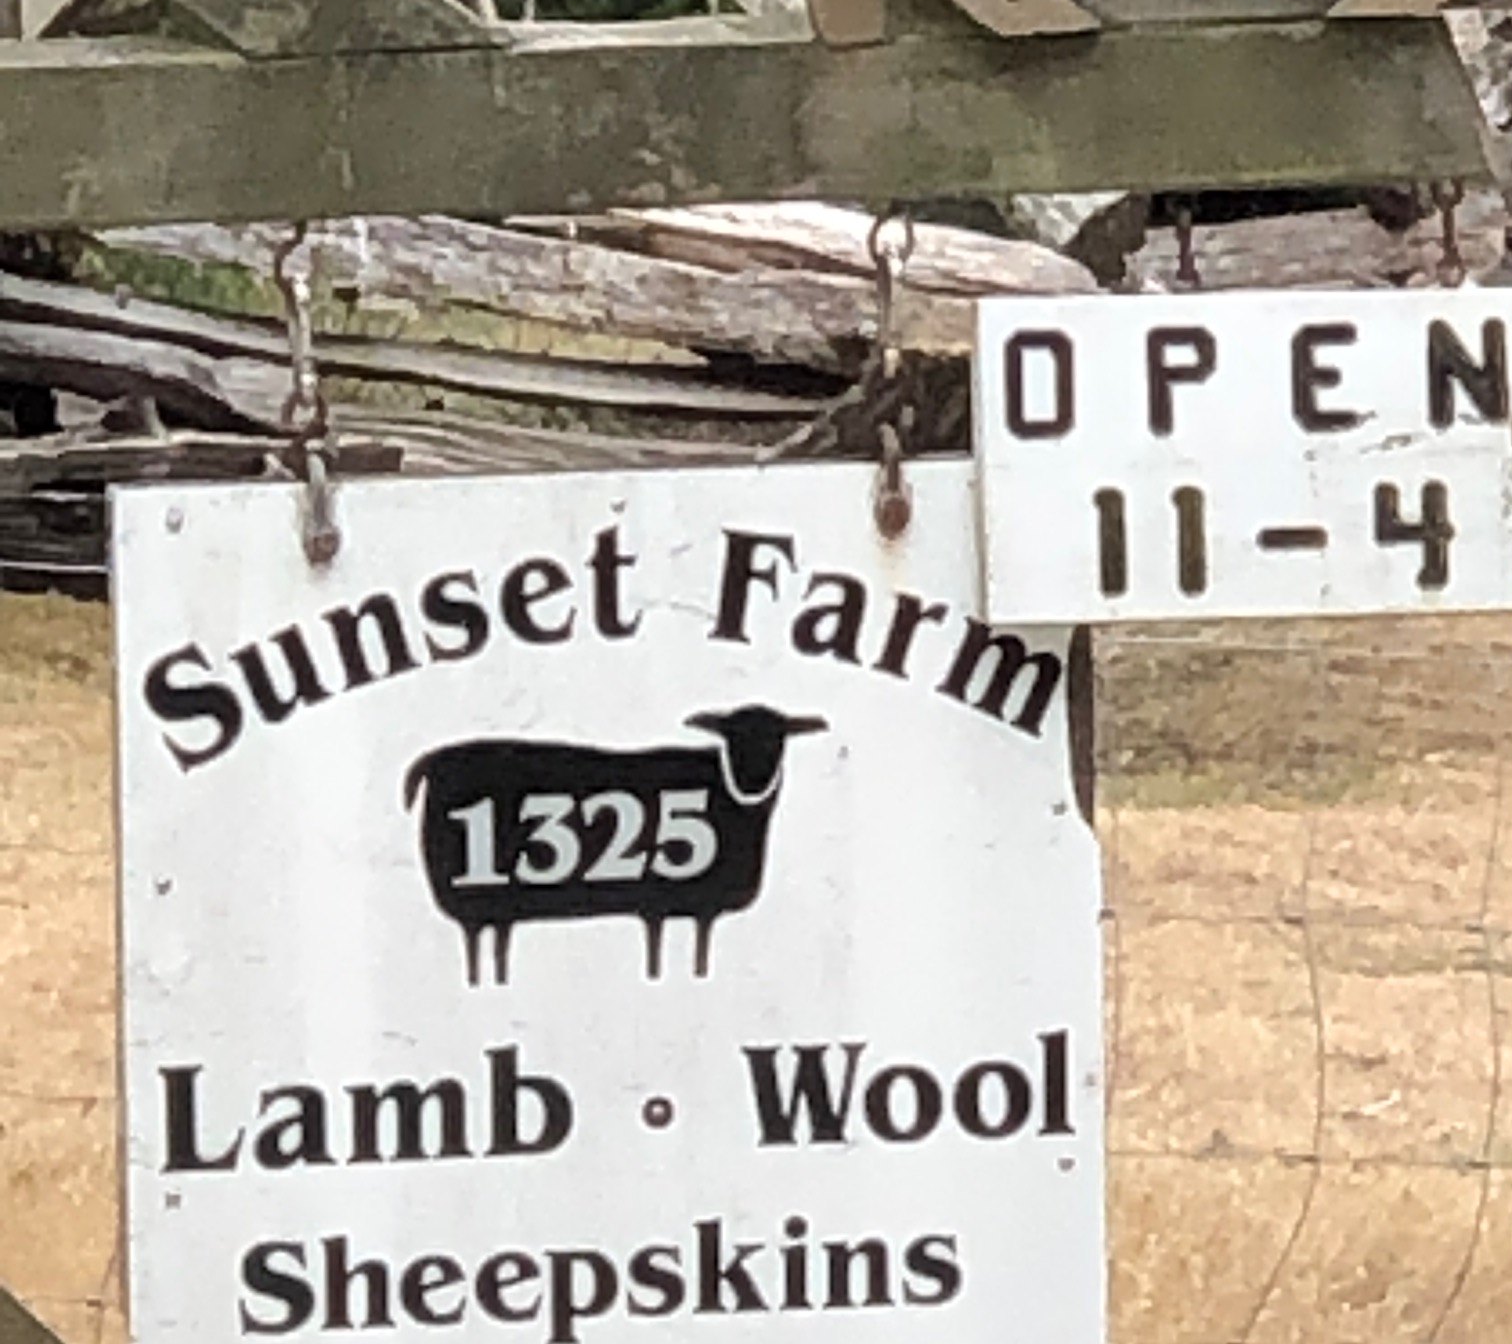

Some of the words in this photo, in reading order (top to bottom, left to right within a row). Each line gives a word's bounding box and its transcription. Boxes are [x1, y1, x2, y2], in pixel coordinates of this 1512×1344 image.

[1004, 317, 1509, 439] OPEN
[143, 523, 641, 775] Sunset
[709, 526, 1063, 737] Farm
[446, 790, 718, 888] 1325
[158, 1044, 575, 1175] Lamb
[743, 1028, 1075, 1147] Wool
